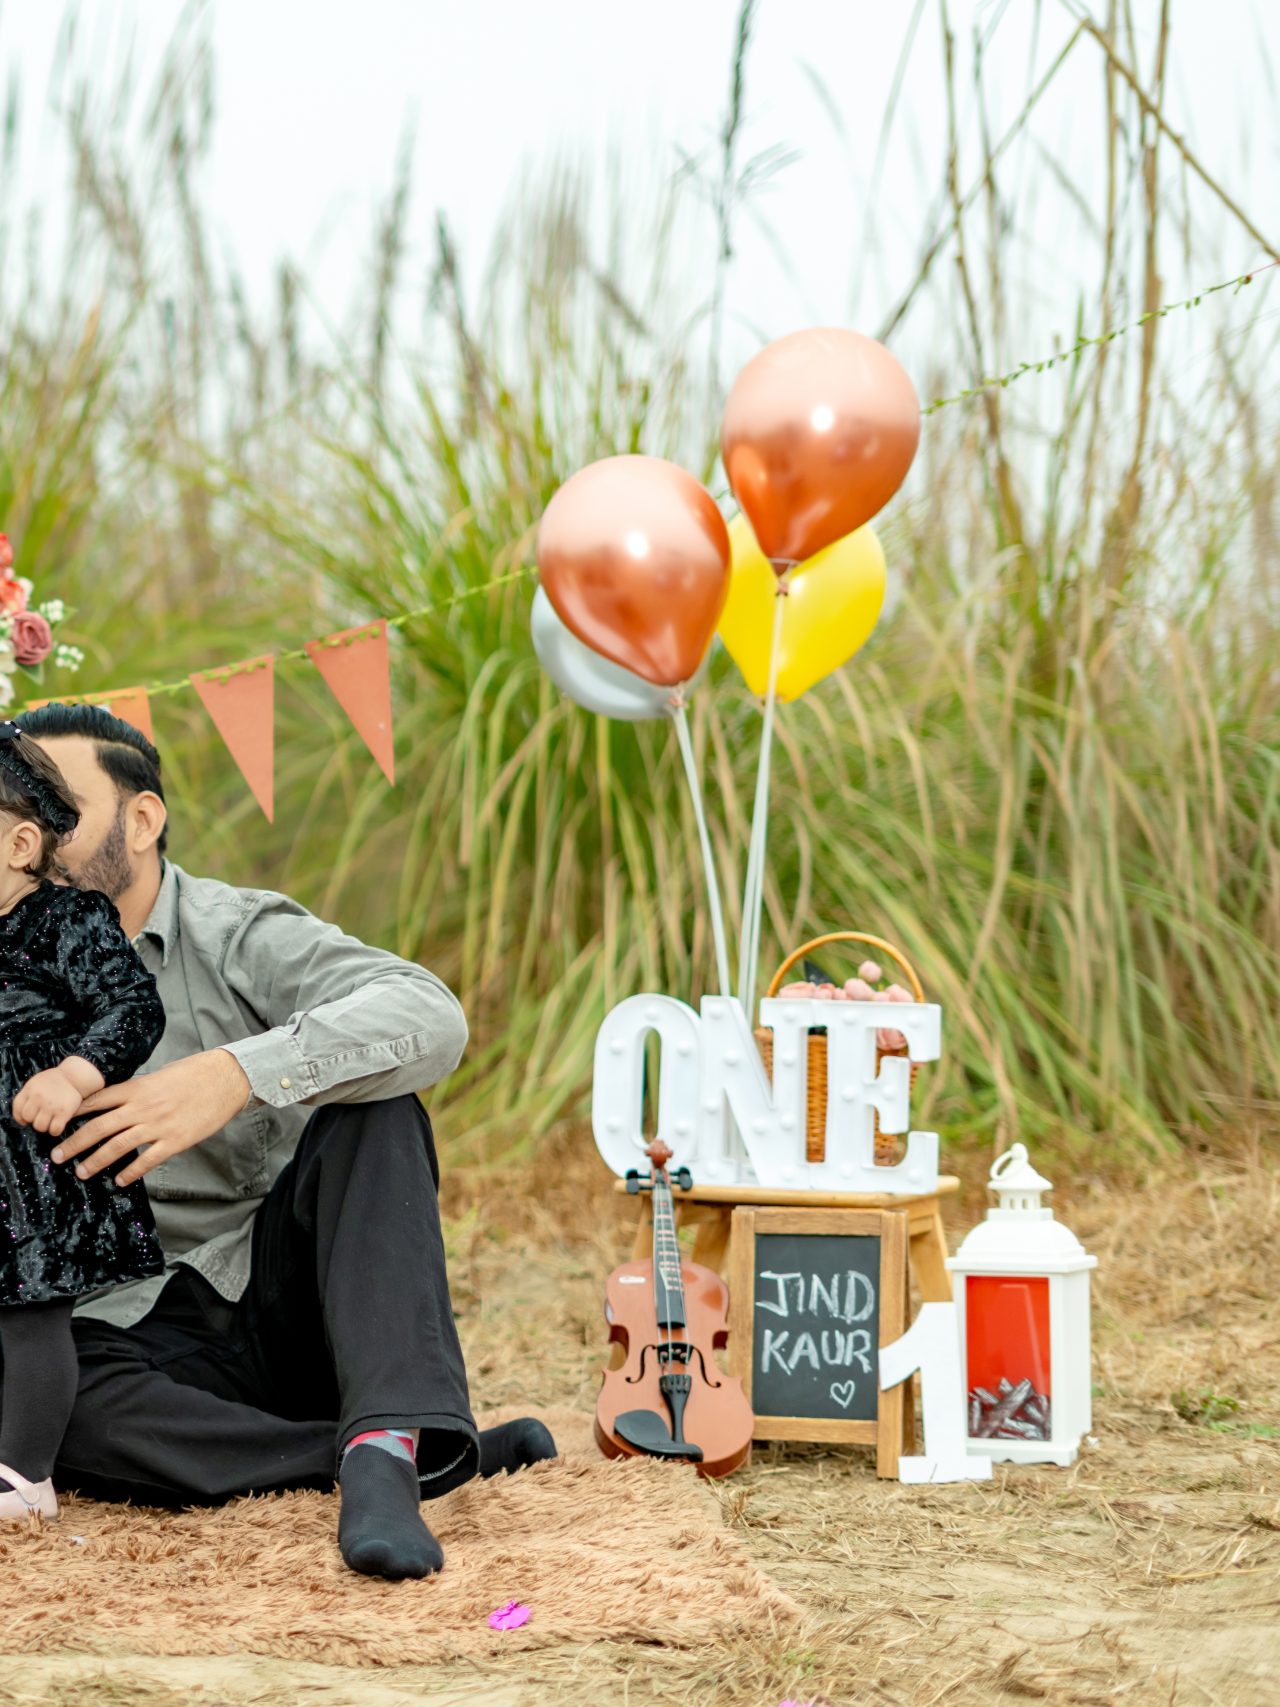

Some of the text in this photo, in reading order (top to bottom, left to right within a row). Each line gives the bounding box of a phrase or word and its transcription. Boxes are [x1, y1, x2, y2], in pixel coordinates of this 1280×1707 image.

[592, 993, 941, 1194] ONE
[755, 1270, 875, 1324] JIND
[761, 1329, 872, 1375] KAUR
[879, 1302, 993, 1484] 1
